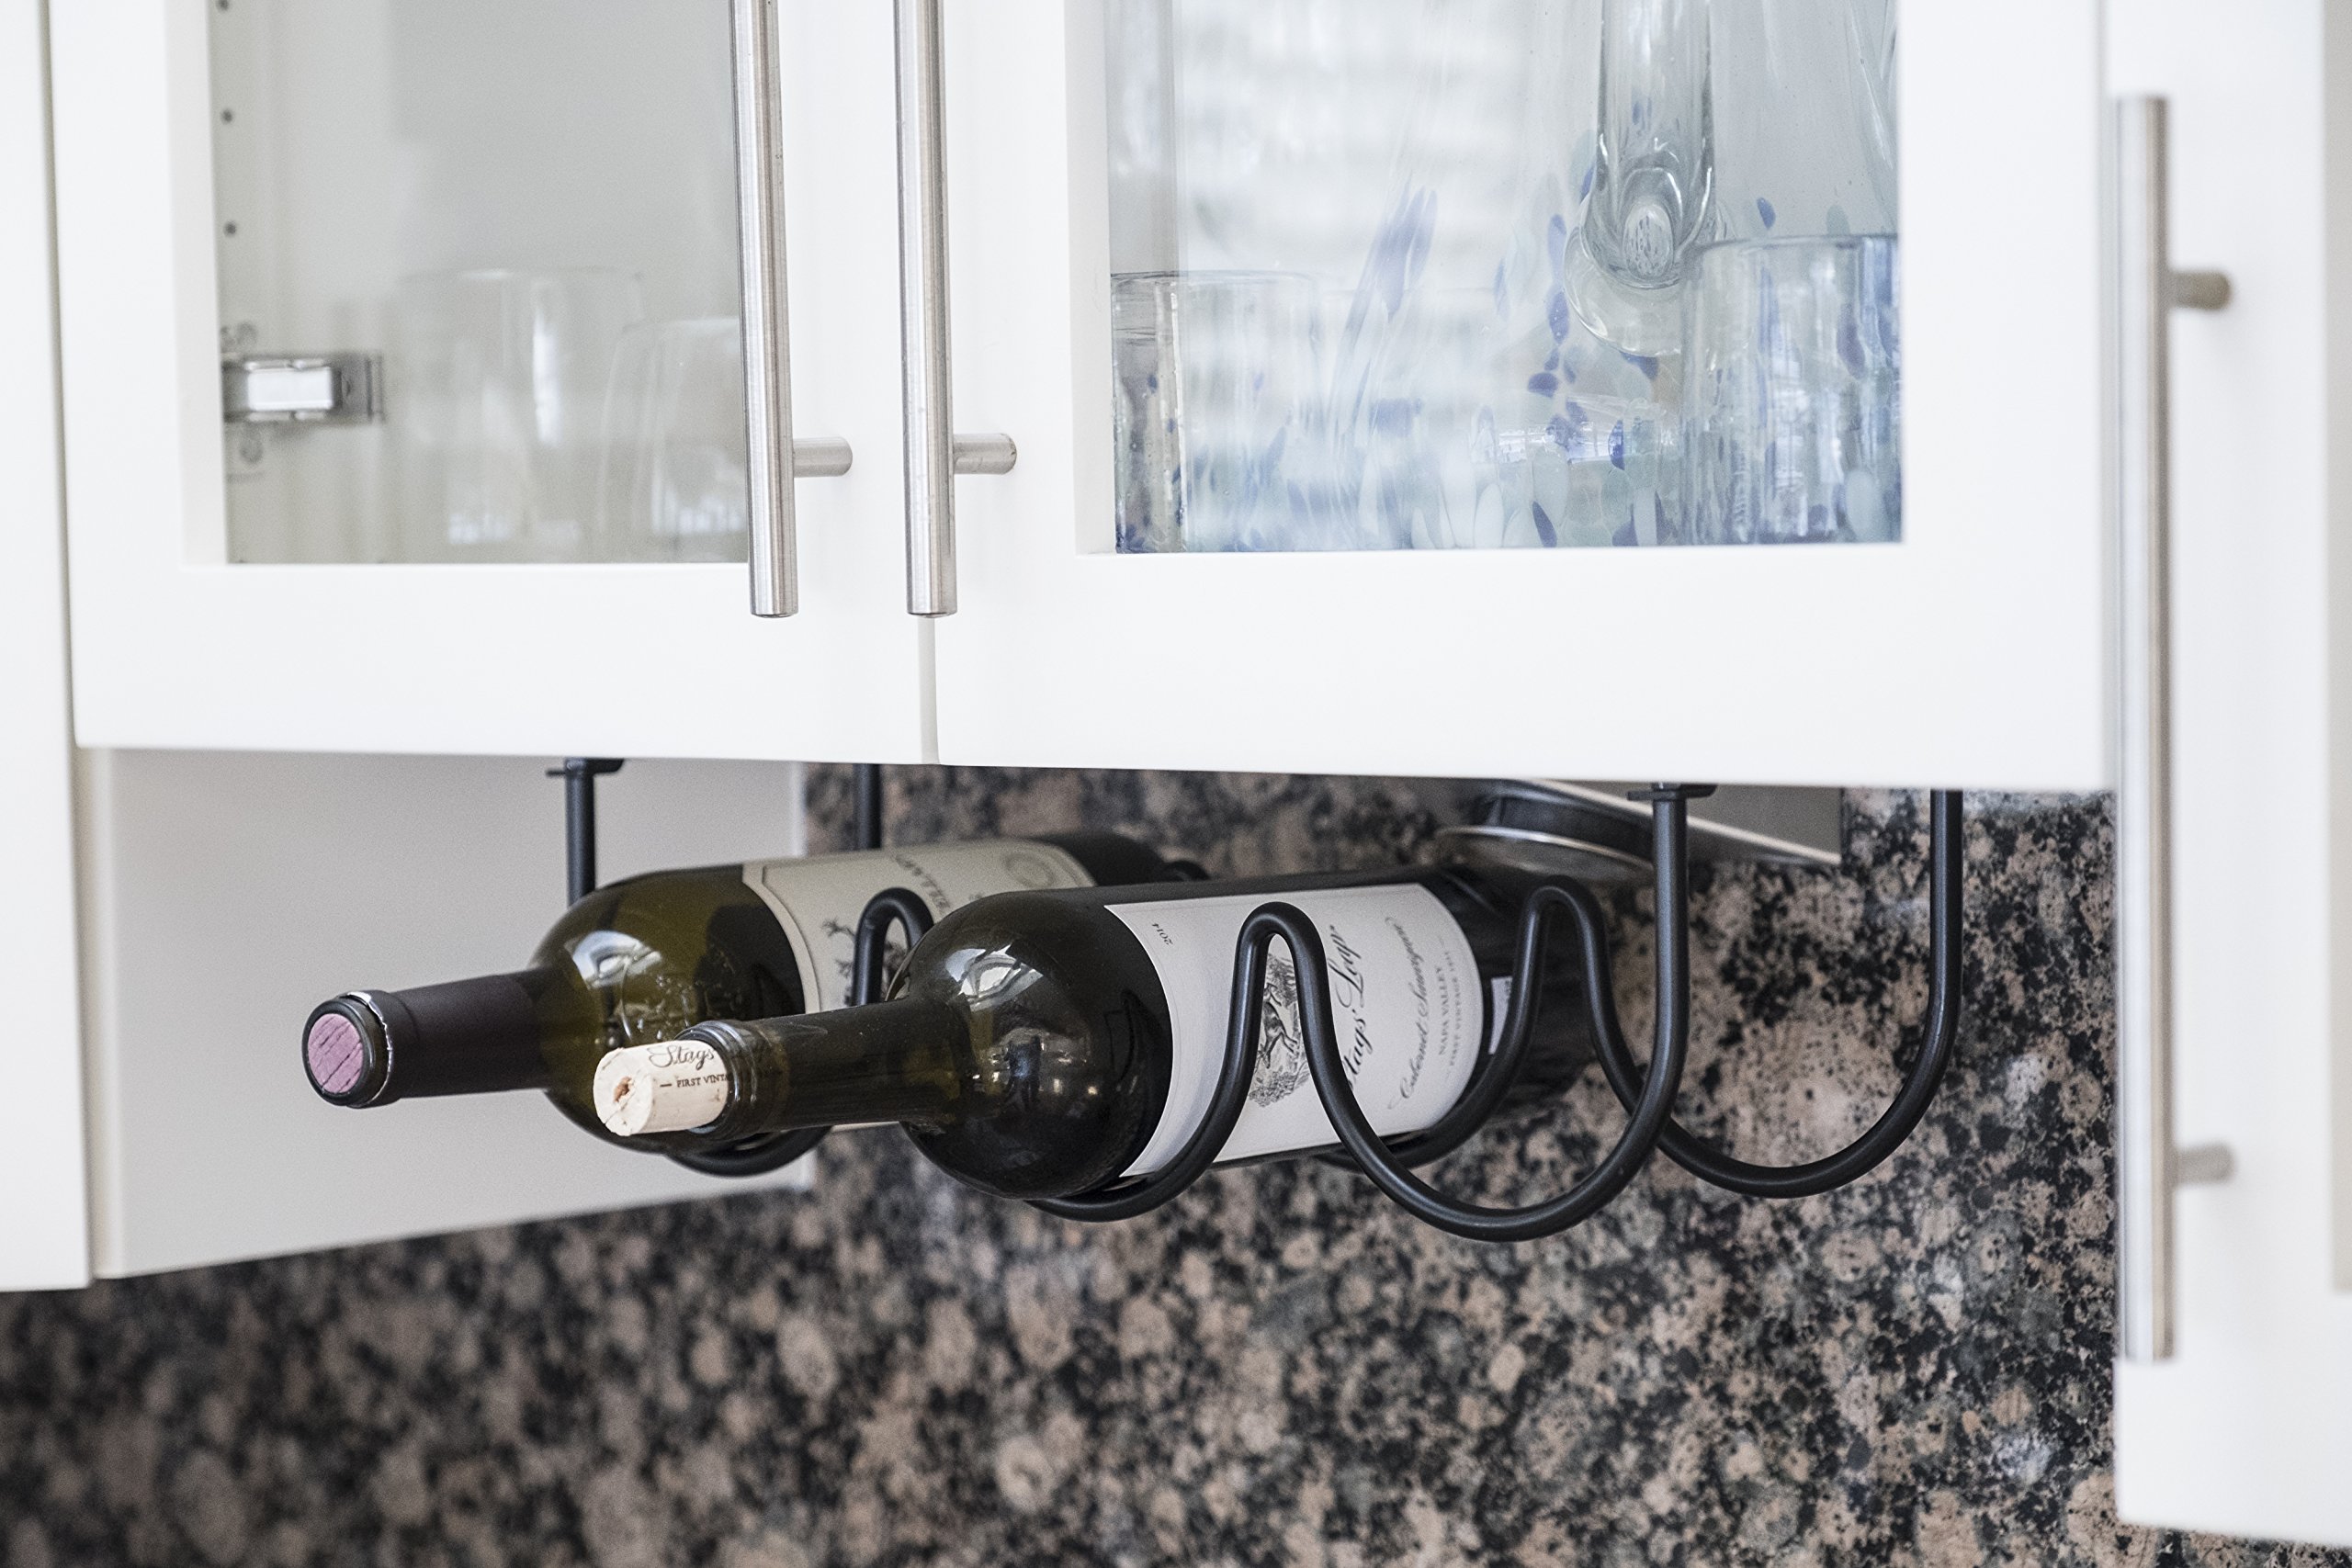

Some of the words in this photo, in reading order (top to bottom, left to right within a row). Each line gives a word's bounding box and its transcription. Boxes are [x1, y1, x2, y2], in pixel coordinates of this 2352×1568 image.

[1151, 922, 1174, 946] 2014
[1385, 916, 1429, 1021] Sauvignon
[1434, 964, 1450, 1017] VALLEY
[1341, 1009, 1373, 1091] tags'
[1437, 1019, 1450, 1056] NAPA
[677, 1077, 701, 1088] FIRST
[1387, 1021, 1429, 1111] Cabernet
